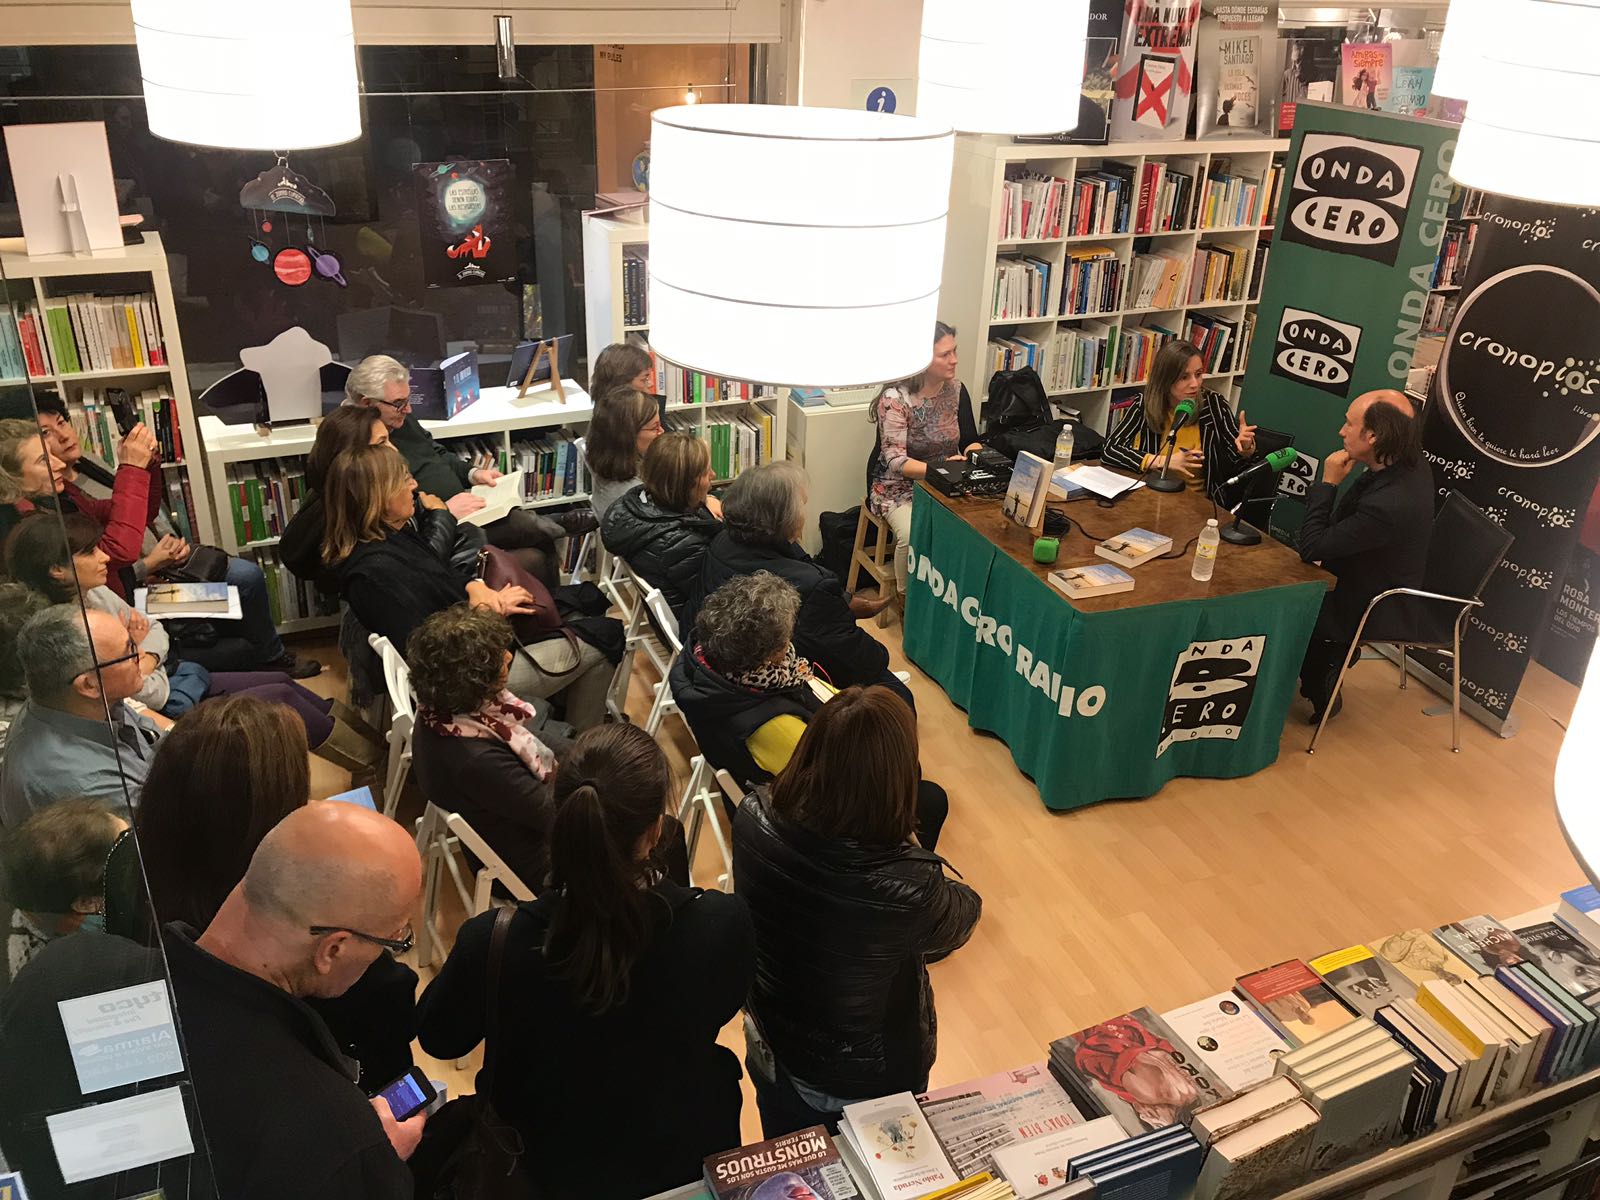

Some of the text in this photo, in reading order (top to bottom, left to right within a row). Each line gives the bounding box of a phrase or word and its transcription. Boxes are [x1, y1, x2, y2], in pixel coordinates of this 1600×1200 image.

[1134, 26, 1192, 47] EXTREMA
[1224, 40, 1254, 54] MIKEL
[1223, 54, 1254, 65] SANTIAGO
[1310, 157, 1394, 191] ONDA
[1418, 139, 1458, 247] CERO
[1304, 202, 1386, 239] CERO
[1483, 211, 1555, 240] cronopios
[1387, 262, 1435, 379] ONDA
[1289, 323, 1344, 352] ONDA
[1286, 351, 1339, 380] CERO
[1459, 331, 1600, 395] cronopios
[1455, 391, 1468, 419] Quien
[1485, 440, 1507, 455] quiere
[1519, 448, 1541, 459] hará
[1542, 446, 1560, 457] leer
[1290, 461, 1308, 475] DA
[1279, 472, 1305, 494] ERO
[1498, 486, 1575, 529] cronopios
[907, 545, 958, 612] ONDA
[1563, 584, 1590, 605] ROSA
[960, 596, 1013, 657] CRO
[1191, 639, 1254, 657] NDA
[1438, 662, 1506, 710] crnopios
[1170, 701, 1238, 724] ERO
[1451, 925, 1495, 941] OBAMA
[1458, 932, 1513, 954] MICHELLE
[1018, 1126, 1044, 1139] BIEN
[1044, 1112, 1076, 1131] TODAS
[774, 1131, 817, 1148] EMIL FERRIS
[715, 1135, 828, 1180] MONSTRUOS
[788, 1159, 804, 1168] MÁS
[804, 1153, 817, 1163] QUE
[726, 1175, 740, 1185] LOS
[741, 1171, 755, 1180] SON
[755, 1166, 777, 1176] GUSTA
[893, 1172, 945, 1192] Pablo Neruda
